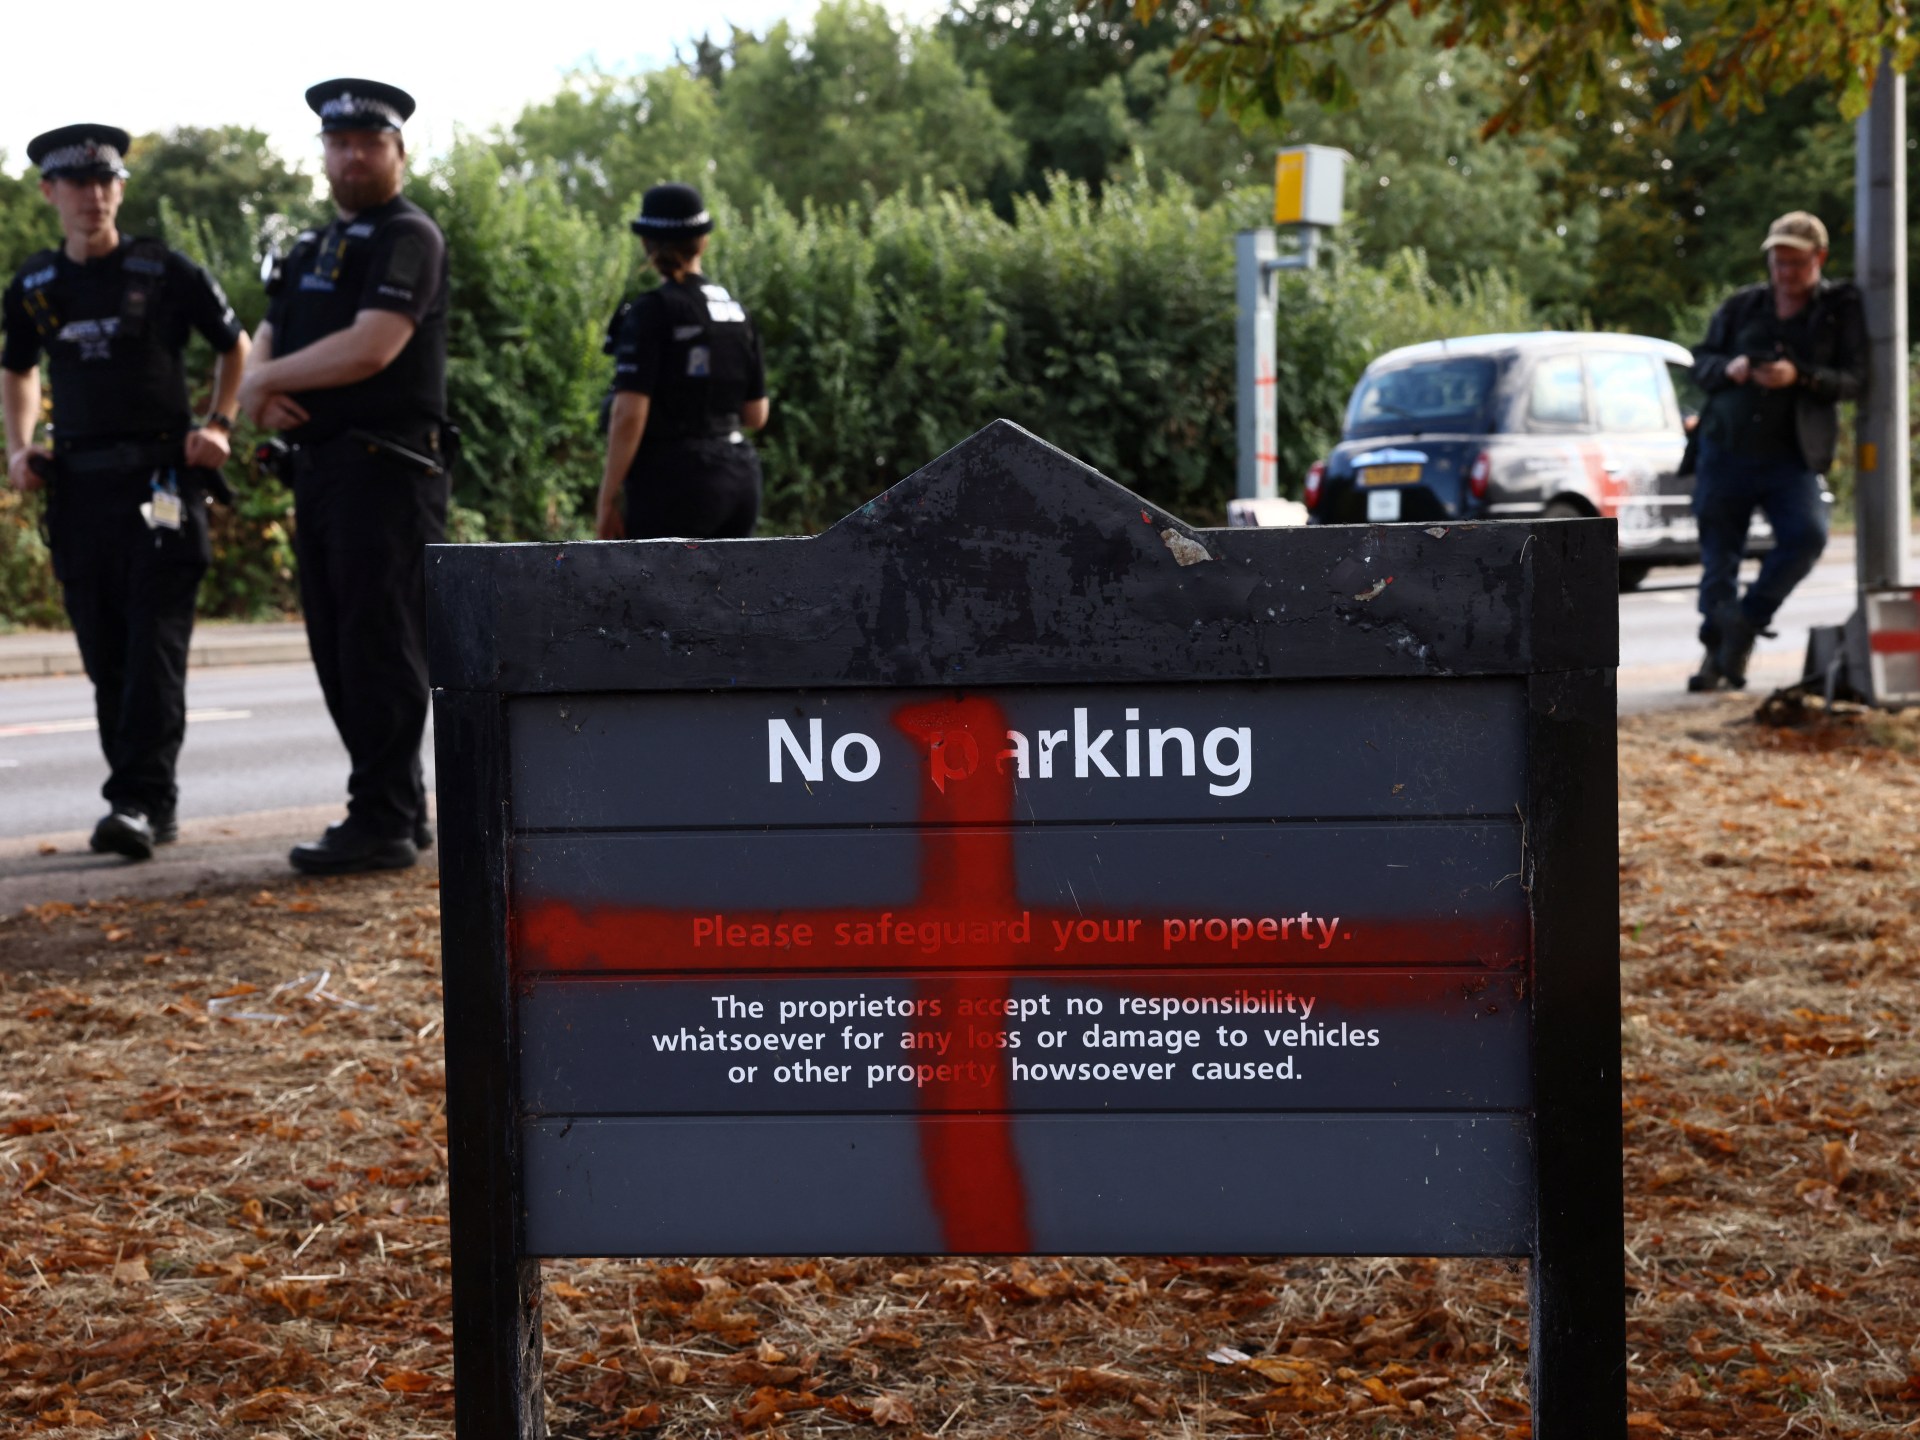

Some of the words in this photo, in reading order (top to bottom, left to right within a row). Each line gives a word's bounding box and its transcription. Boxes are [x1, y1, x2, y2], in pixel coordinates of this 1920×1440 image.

[768, 718, 881, 783] No
[931, 707, 1252, 797] parking
[693, 915, 813, 948] Please
[835, 911, 1031, 952] safeguard
[1052, 918, 1142, 951] your
[1163, 912, 1351, 950] property.
[712, 995, 764, 1019] The
[780, 994, 942, 1024] proprietors
[958, 994, 1051, 1022] accept
[1067, 997, 1104, 1016] no
[1119, 990, 1316, 1021] responsibility
[652, 1027, 826, 1052] whatsoever
[841, 1026, 884, 1050] for
[900, 1031, 952, 1056] any
[969, 1025, 1022, 1049] loss
[1037, 1029, 1068, 1048] or
[1082, 1024, 1201, 1054] damage
[1217, 1025, 1248, 1047] to
[1264, 1022, 1380, 1048] vehicles
[728, 1065, 758, 1083] or
[773, 1059, 852, 1083] other
[867, 1060, 997, 1088] property
[1012, 1057, 1176, 1081] howsoever
[1191, 1056, 1303, 1080] caused.
